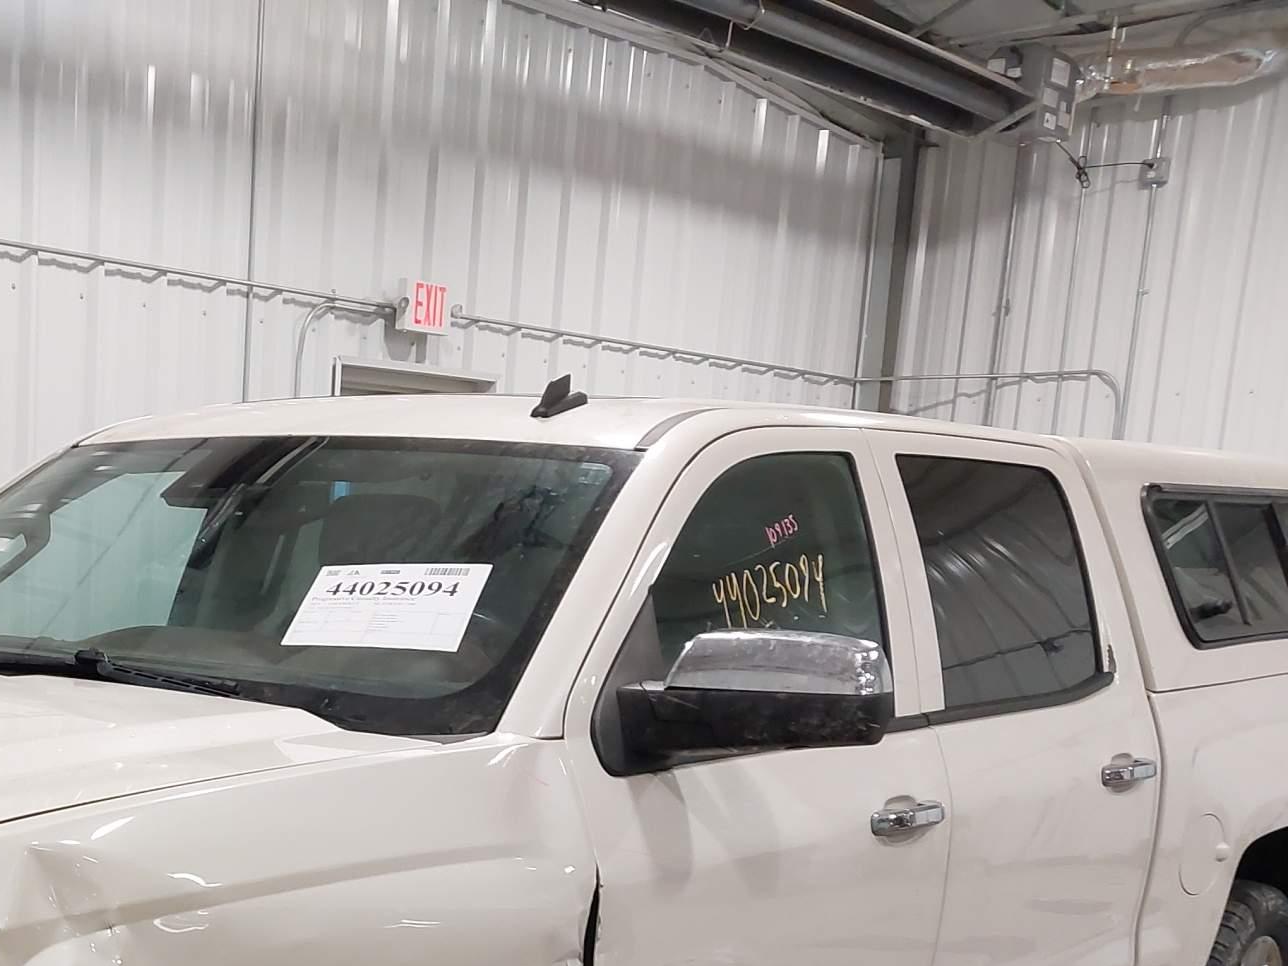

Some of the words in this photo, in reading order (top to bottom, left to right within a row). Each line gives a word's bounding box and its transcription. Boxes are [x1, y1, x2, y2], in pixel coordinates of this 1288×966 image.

[414, 282, 448, 328] EXIT
[325, 581, 461, 597] 44025094
[712, 553, 828, 629] 44025094
